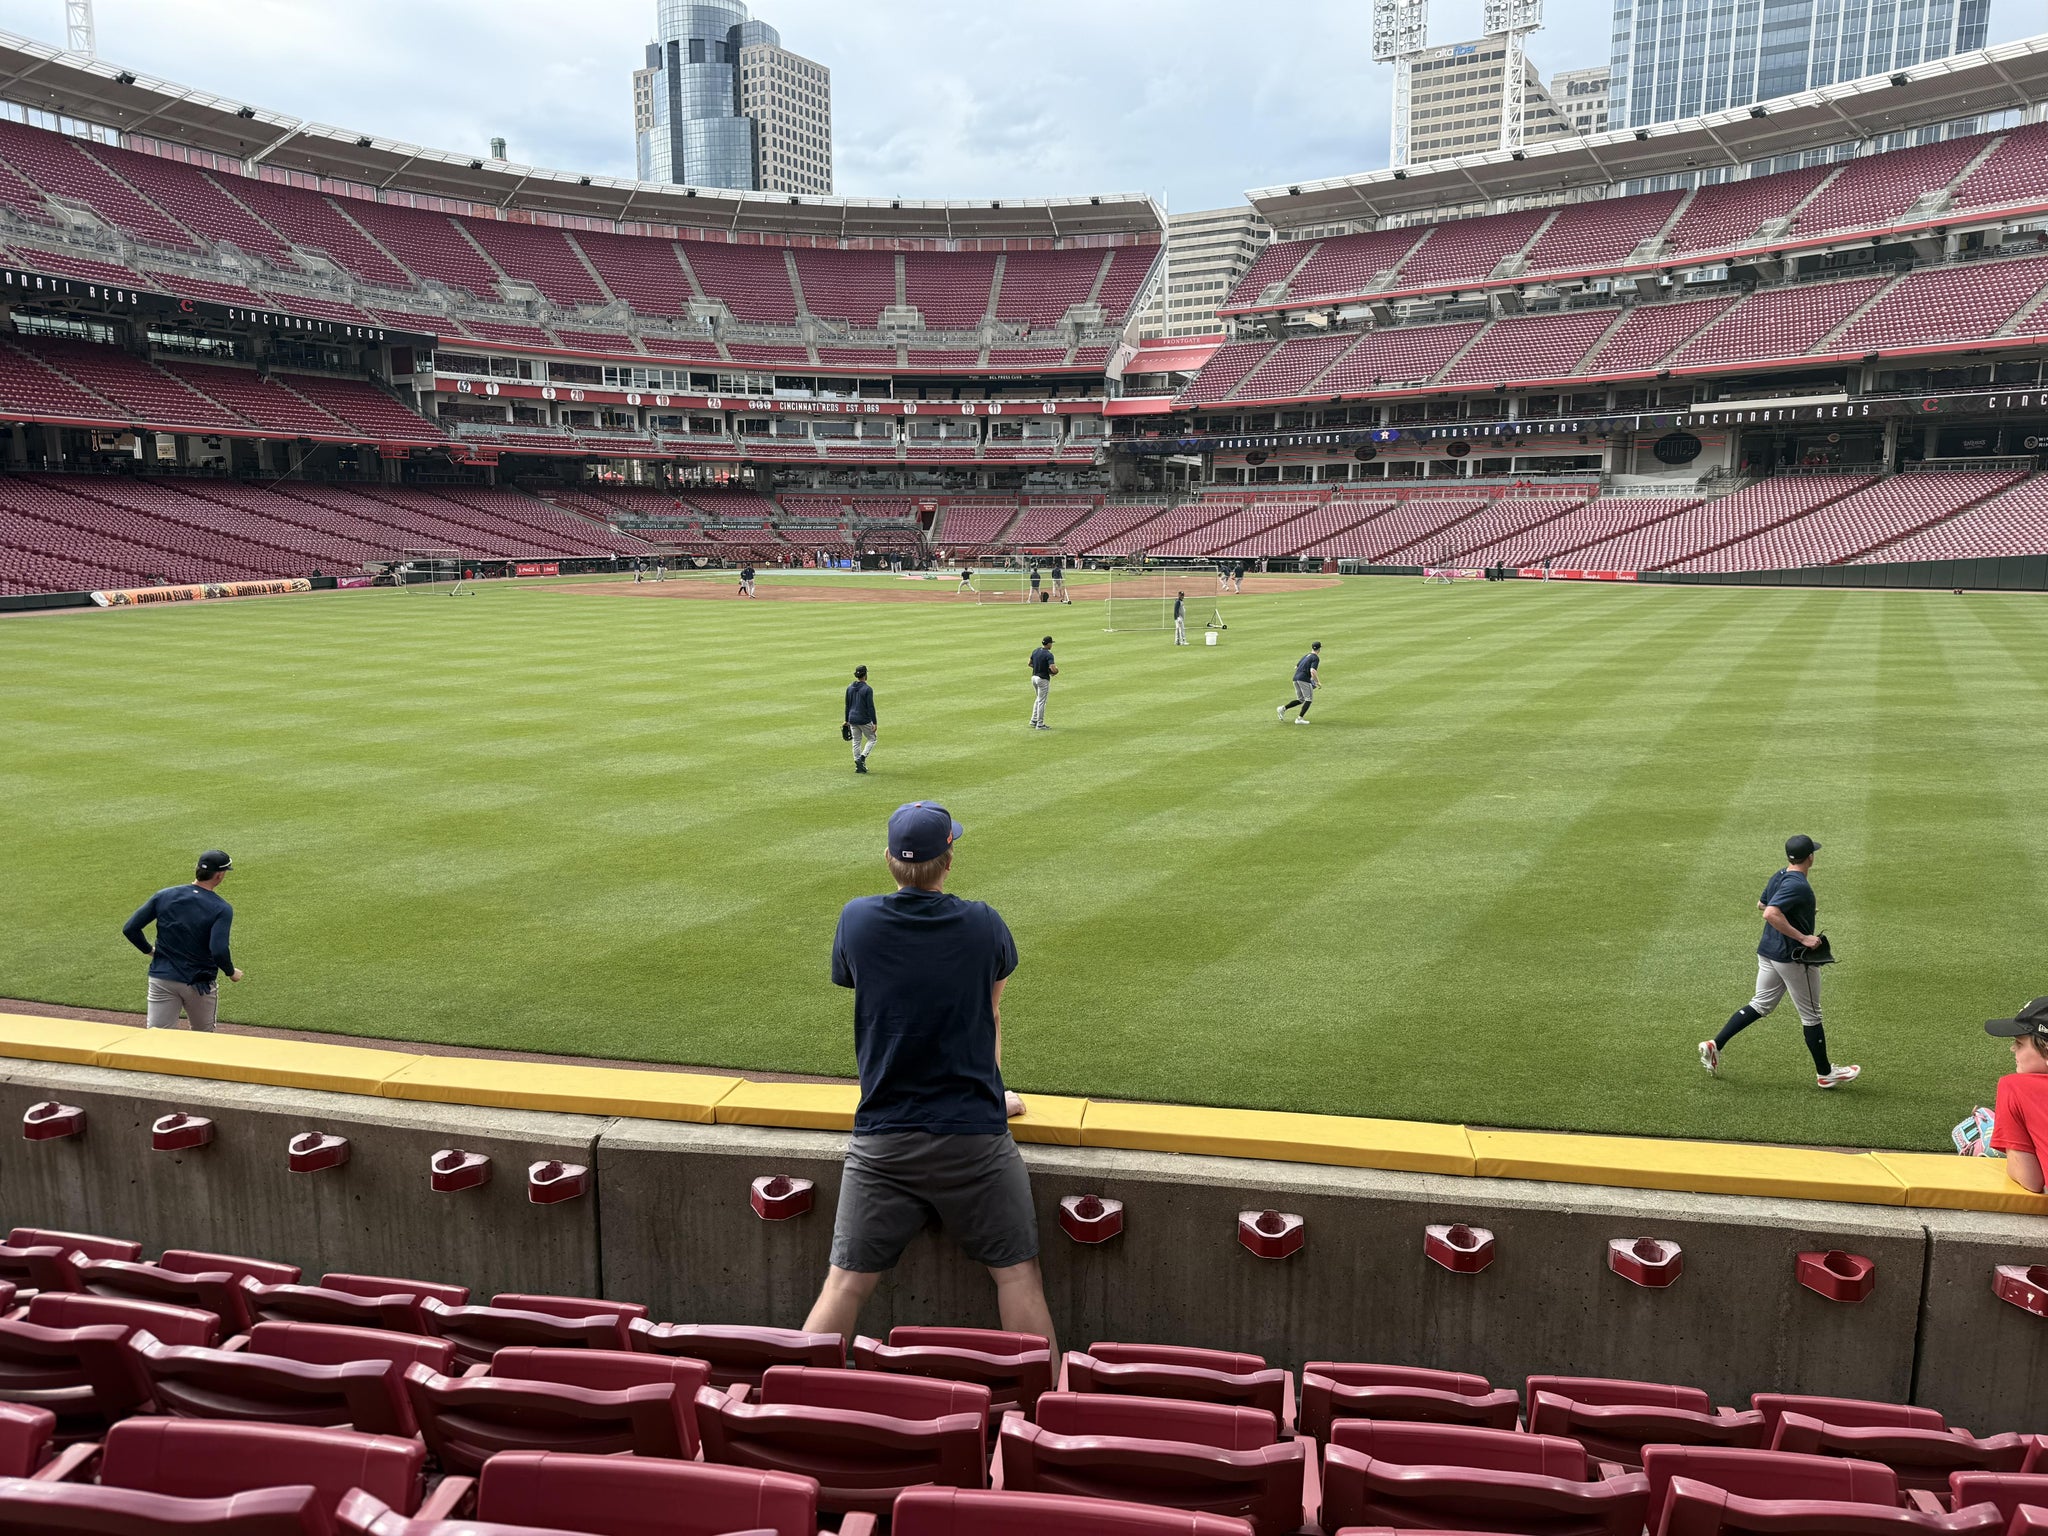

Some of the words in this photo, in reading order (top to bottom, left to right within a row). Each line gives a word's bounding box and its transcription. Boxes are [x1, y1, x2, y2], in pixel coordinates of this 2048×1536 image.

[89, 286, 137, 305] REDS
[229, 308, 332, 334] CINCINNATI
[347, 326, 384, 341] REDS
[457, 381, 470, 393] 42
[571, 389, 583, 401] 20
[780, 401, 819, 412] CINCINNATI
[821, 402, 839, 412] REDS
[845, 404, 862, 413] EST.
[864, 404, 880, 413] 1869
[906, 404, 915, 415] 10
[964, 404, 973, 415] 13
[990, 404, 999, 415] 11
[1676, 409, 1796, 426] CINCINNATI
[1816, 405, 1869, 418] REDS
[1431, 426, 1500, 438] HOUSTON
[1515, 422, 1578, 434] ASTROS
[1220, 438, 1277, 448] HOUSTON
[1289, 434, 1340, 445] ASTROS
[136, 591, 173, 604] GORILLA
[173, 589, 195, 602] GLUE
[236, 584, 266, 597] GORILLA
[268, 582, 285, 594] TAPE
